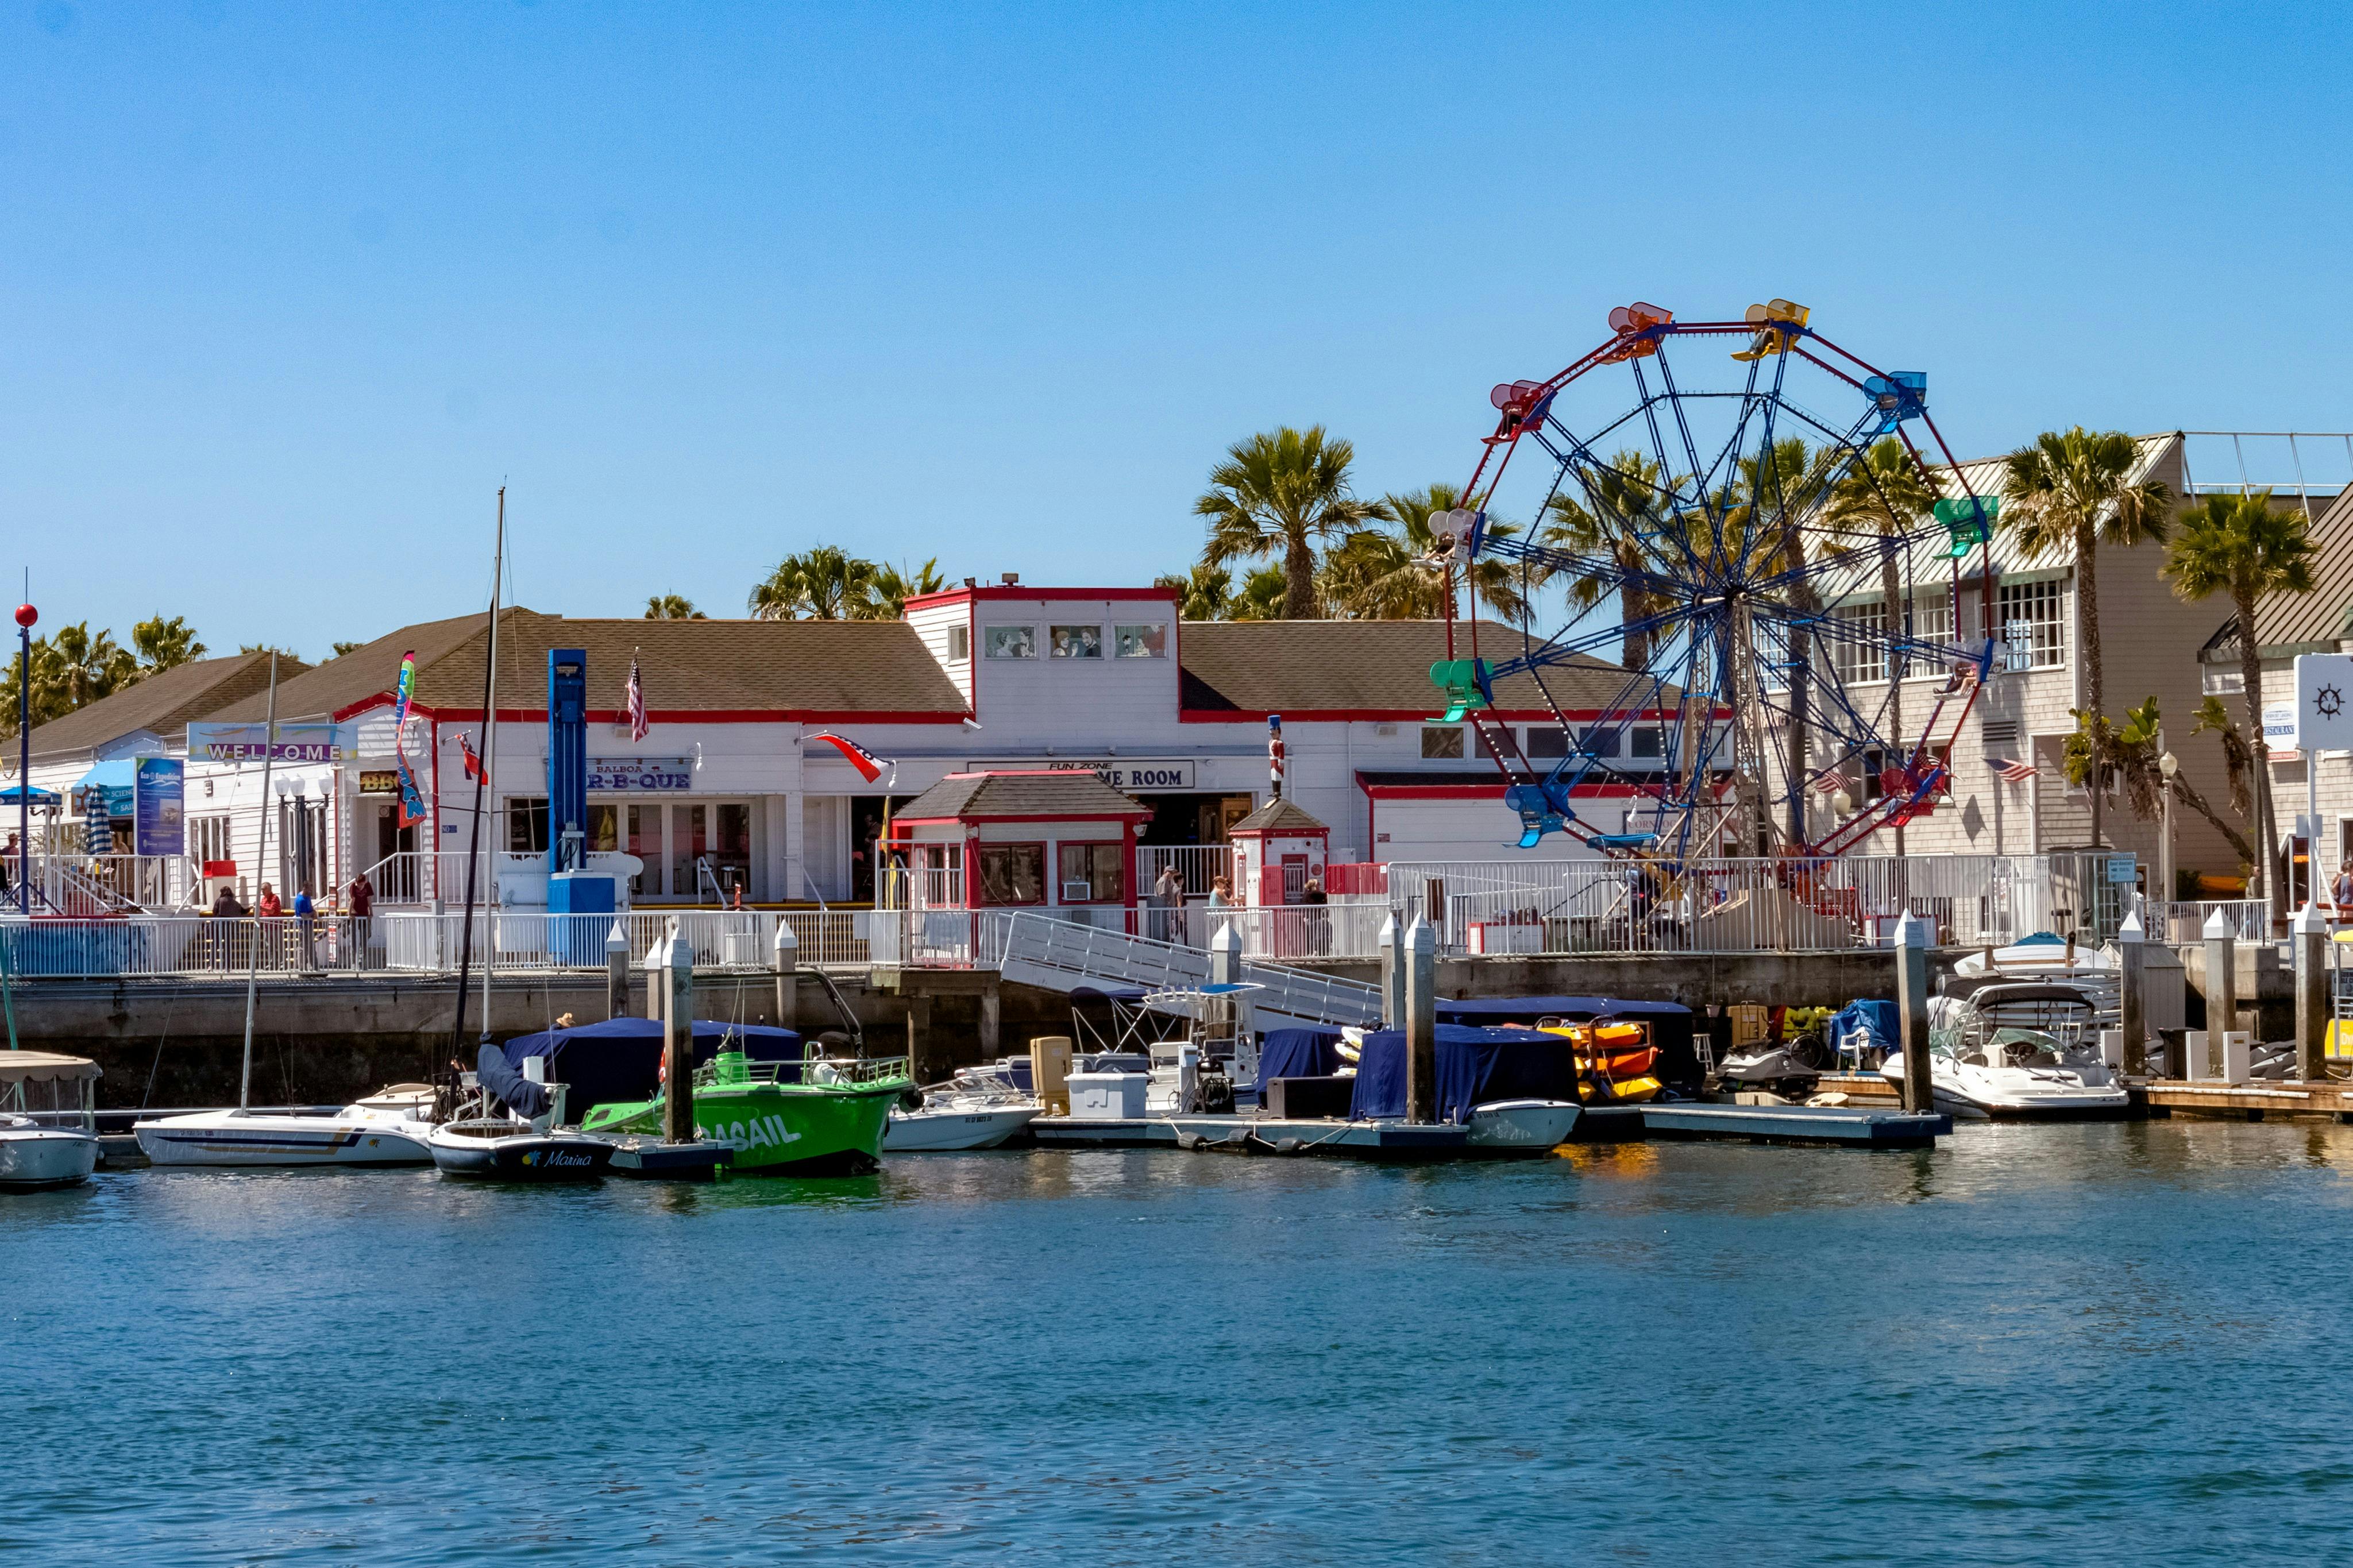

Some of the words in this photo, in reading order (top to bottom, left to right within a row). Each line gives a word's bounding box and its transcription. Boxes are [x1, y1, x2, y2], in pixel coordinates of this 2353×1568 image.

[207, 744, 341, 760] WELCOME
[587, 774, 690, 790] R-B-QUE
[1098, 770, 1124, 786] ME
[1132, 771, 1182, 785] ROOM
[693, 1115, 803, 1152] ASAIL
[543, 1150, 592, 1168] Marina
